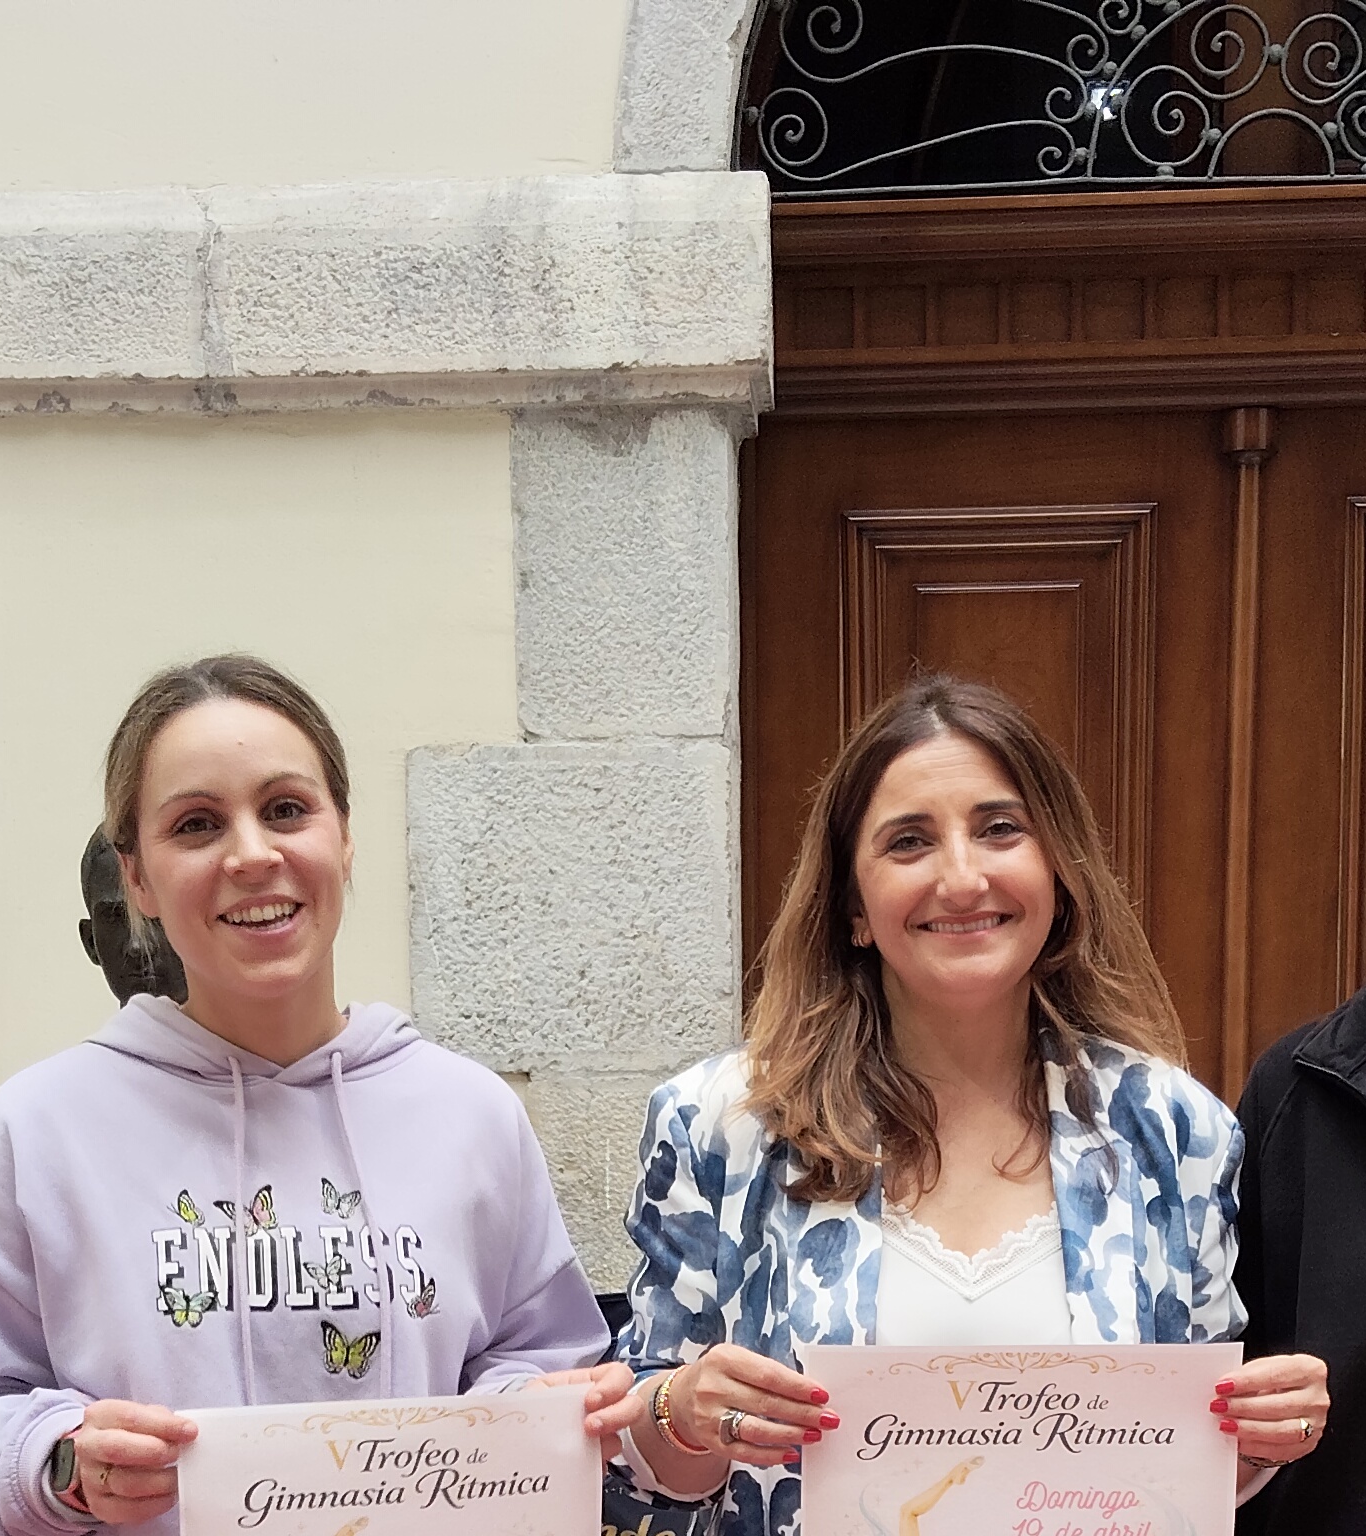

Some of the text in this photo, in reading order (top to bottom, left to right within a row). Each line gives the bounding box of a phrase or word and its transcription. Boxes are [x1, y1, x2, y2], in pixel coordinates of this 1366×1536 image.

[151, 1224, 425, 1314] ENDLESS
[947, 1380, 1109, 1420] V Trofeo de
[325, 1437, 489, 1478] V Trofeo de
[856, 1412, 1175, 1461] Gimnasia Rítmica
[237, 1467, 551, 1529] Gimnasia Rítmica
[1016, 1481, 1140, 1520] Domingo
